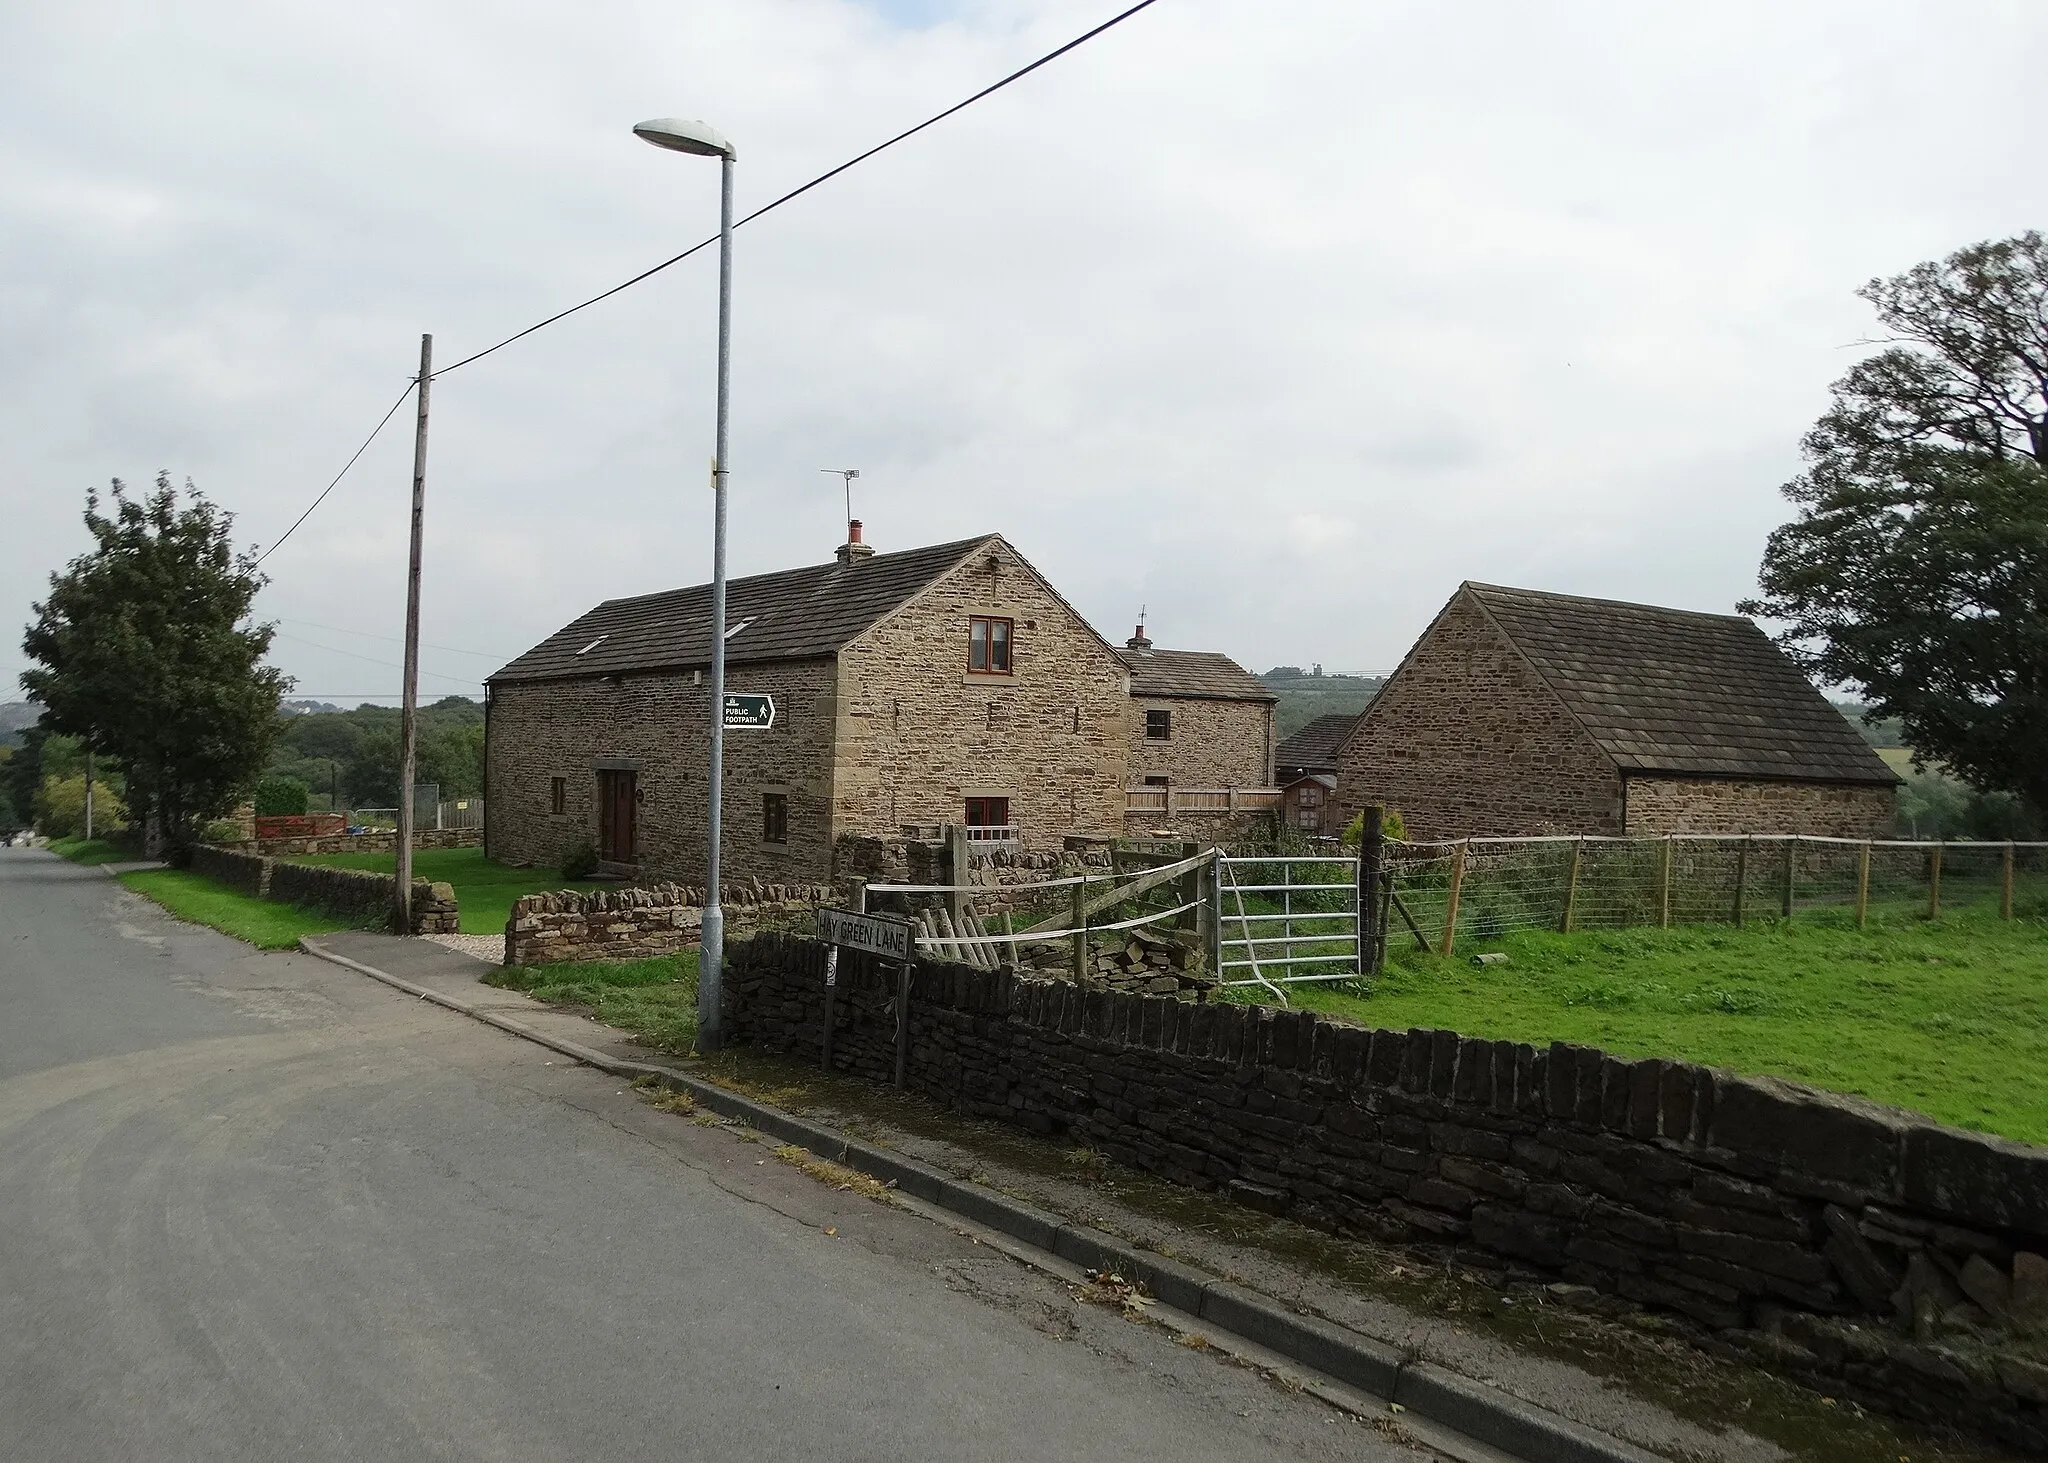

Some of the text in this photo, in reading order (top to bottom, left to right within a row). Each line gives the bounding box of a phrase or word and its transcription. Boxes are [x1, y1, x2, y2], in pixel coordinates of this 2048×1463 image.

[819, 915, 905, 953] HAY GREEN LANE
